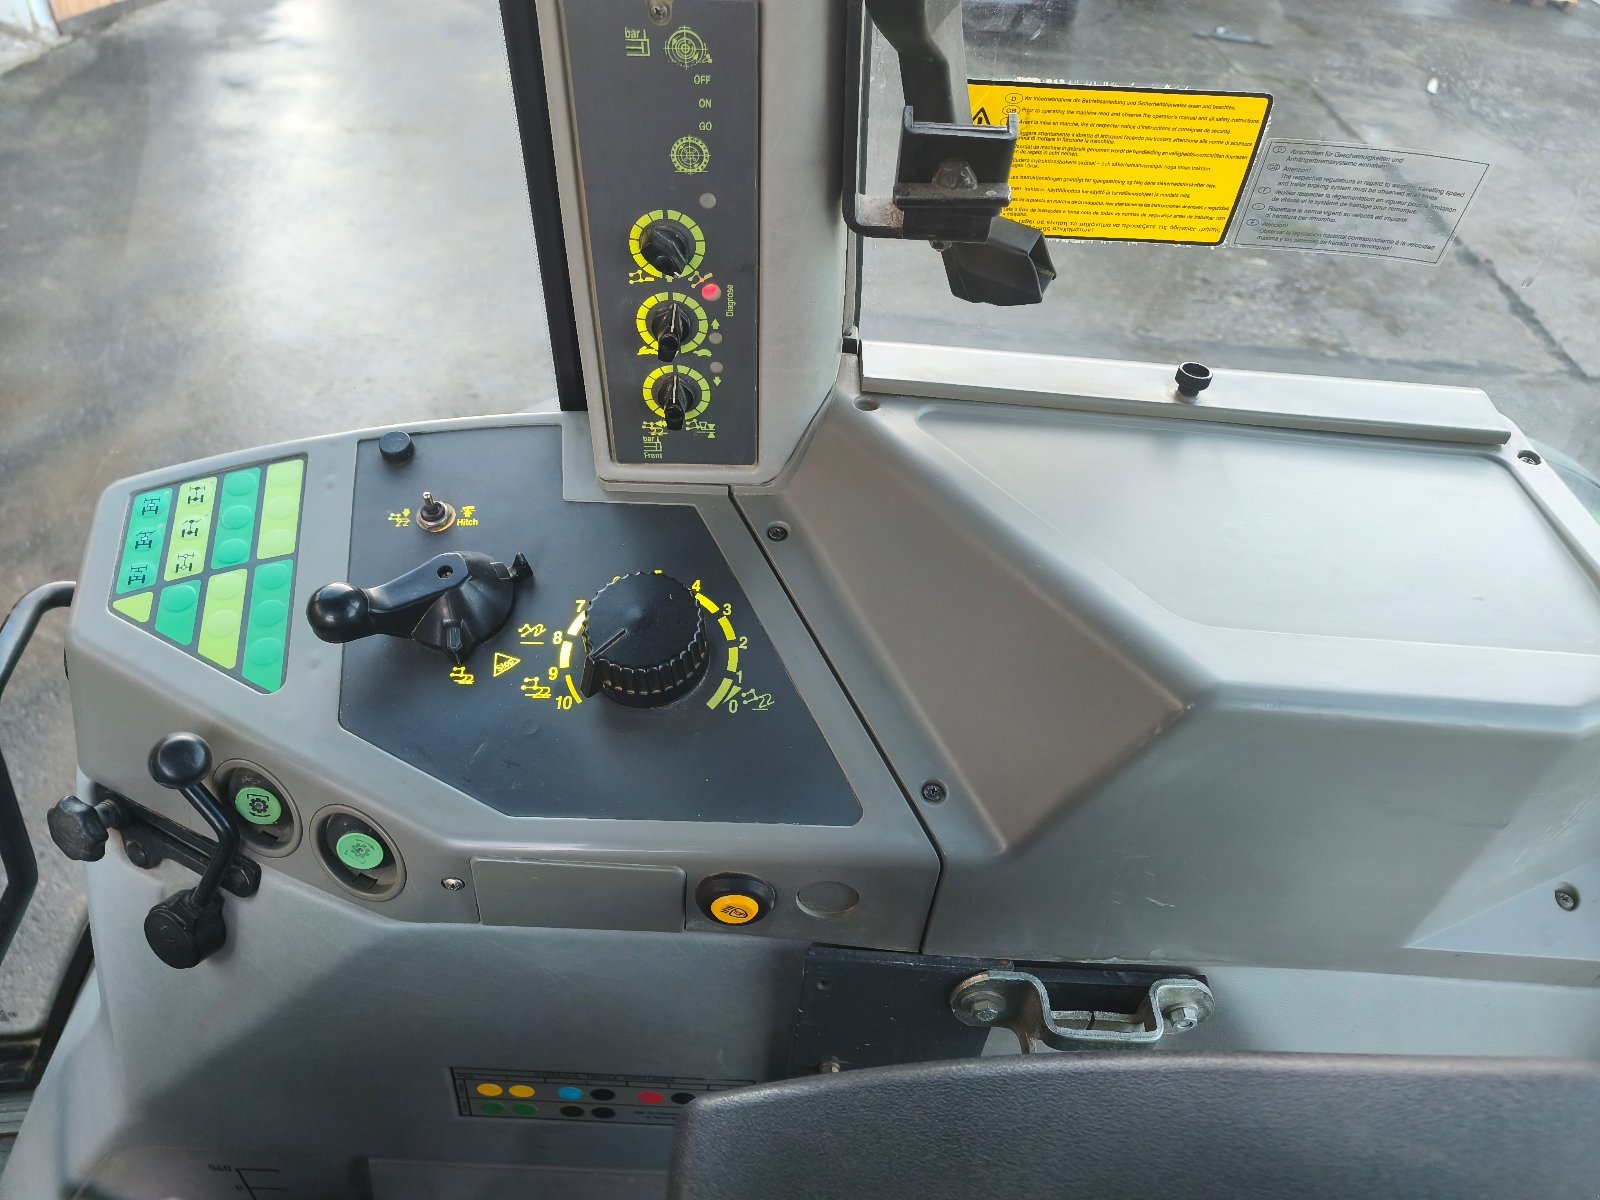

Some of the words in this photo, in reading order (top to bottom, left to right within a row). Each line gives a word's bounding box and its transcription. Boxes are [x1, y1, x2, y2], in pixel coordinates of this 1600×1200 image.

[624, 28, 641, 38] bar
[694, 75, 711, 84] OFF
[698, 98, 712, 108] ON
[698, 122, 712, 131] GO
[726, 284, 736, 317] Diagnose
[692, 580, 701, 592] 4
[575, 600, 586, 612] 7
[722, 603, 732, 615] 3
[553, 631, 563, 644] 8
[739, 637, 748, 649] 2
[496, 658, 514, 672] Stop
[548, 667, 558, 680] 9
[736, 671, 742, 683] 1
[556, 696, 573, 710] 10
[729, 700, 738, 713] 0
